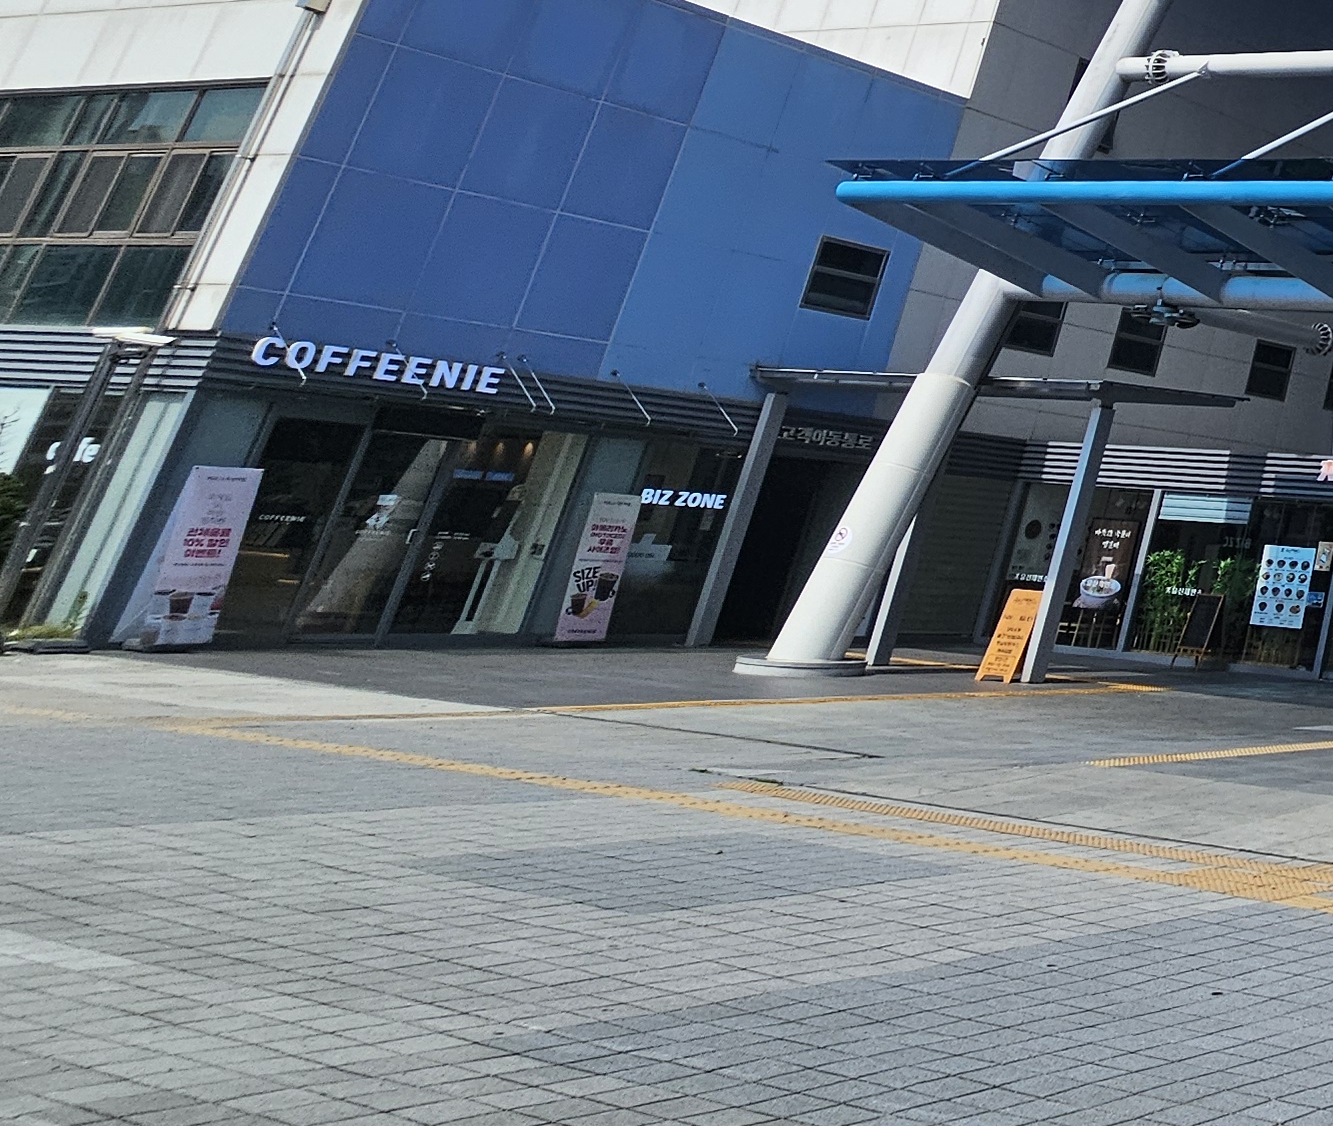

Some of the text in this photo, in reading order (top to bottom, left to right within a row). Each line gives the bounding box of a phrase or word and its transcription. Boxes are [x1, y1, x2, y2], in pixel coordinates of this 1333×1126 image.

[252, 336, 505, 394] COFFEENIE
[46, 437, 101, 474] cfe
[641, 488, 727, 509] BIZ ZONE
[573, 566, 601, 583] SIZE
